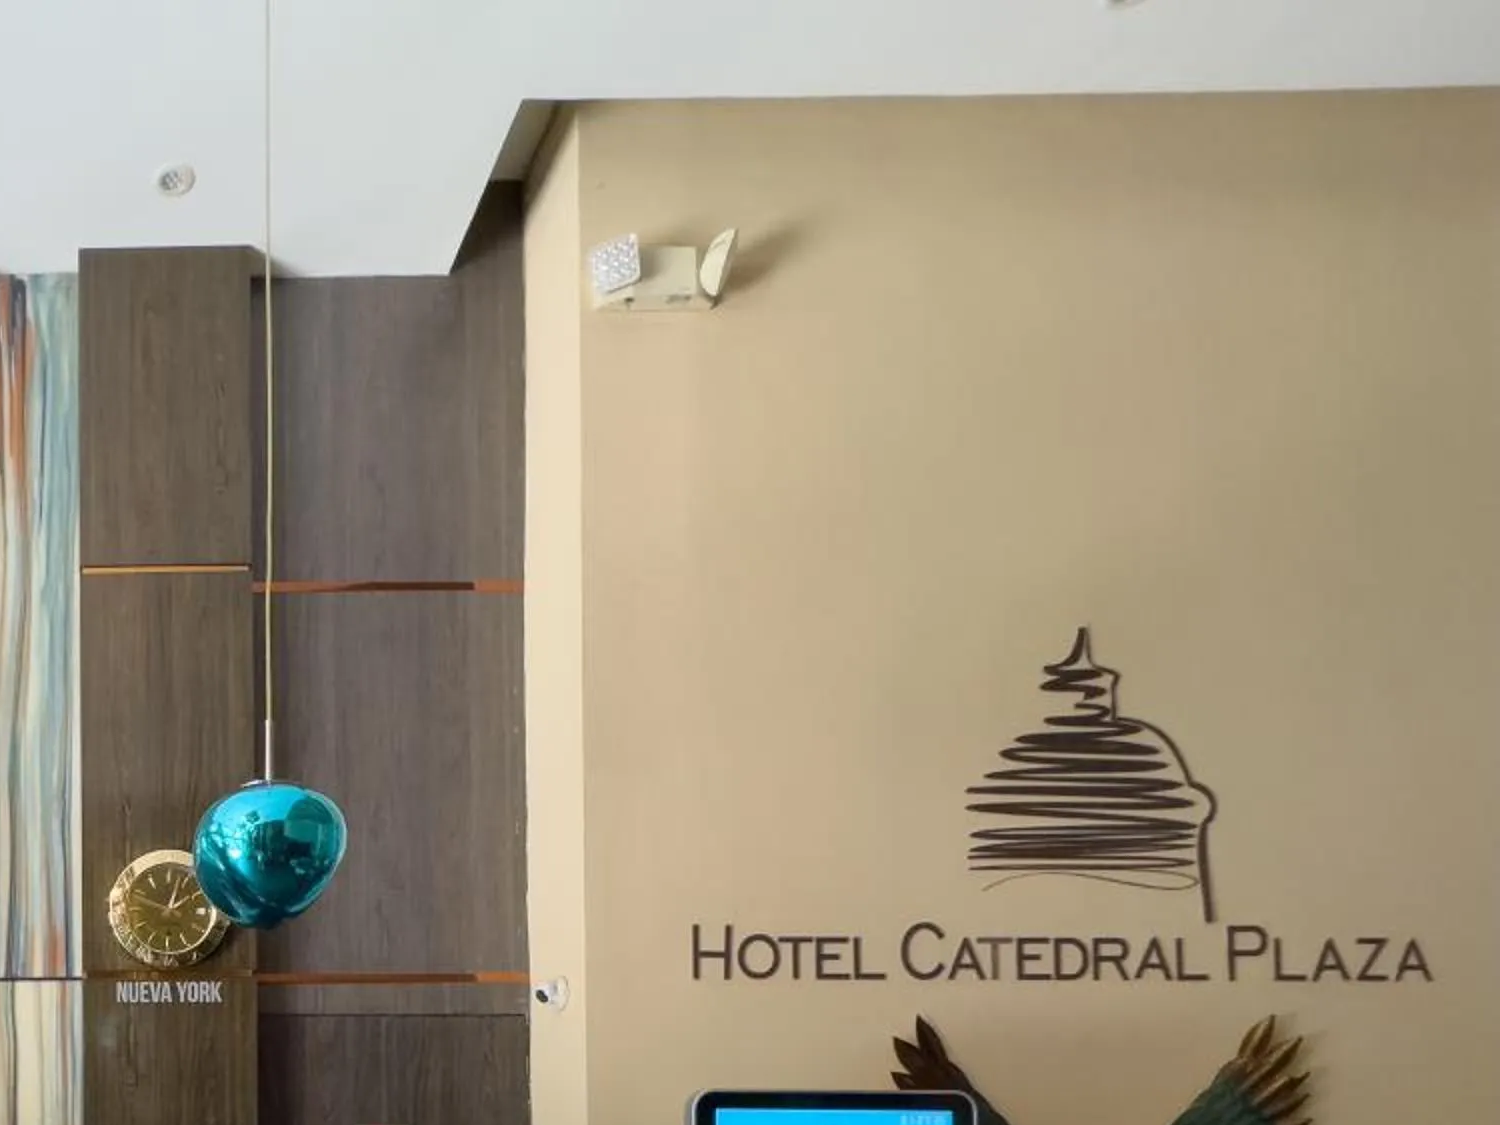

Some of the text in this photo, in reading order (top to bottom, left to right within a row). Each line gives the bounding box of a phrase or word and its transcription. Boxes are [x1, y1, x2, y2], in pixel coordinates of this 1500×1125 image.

[690, 921, 1434, 983] HOTEL CATEDRAL PLAZA
[115, 981, 224, 1004] NUEVA YORK
